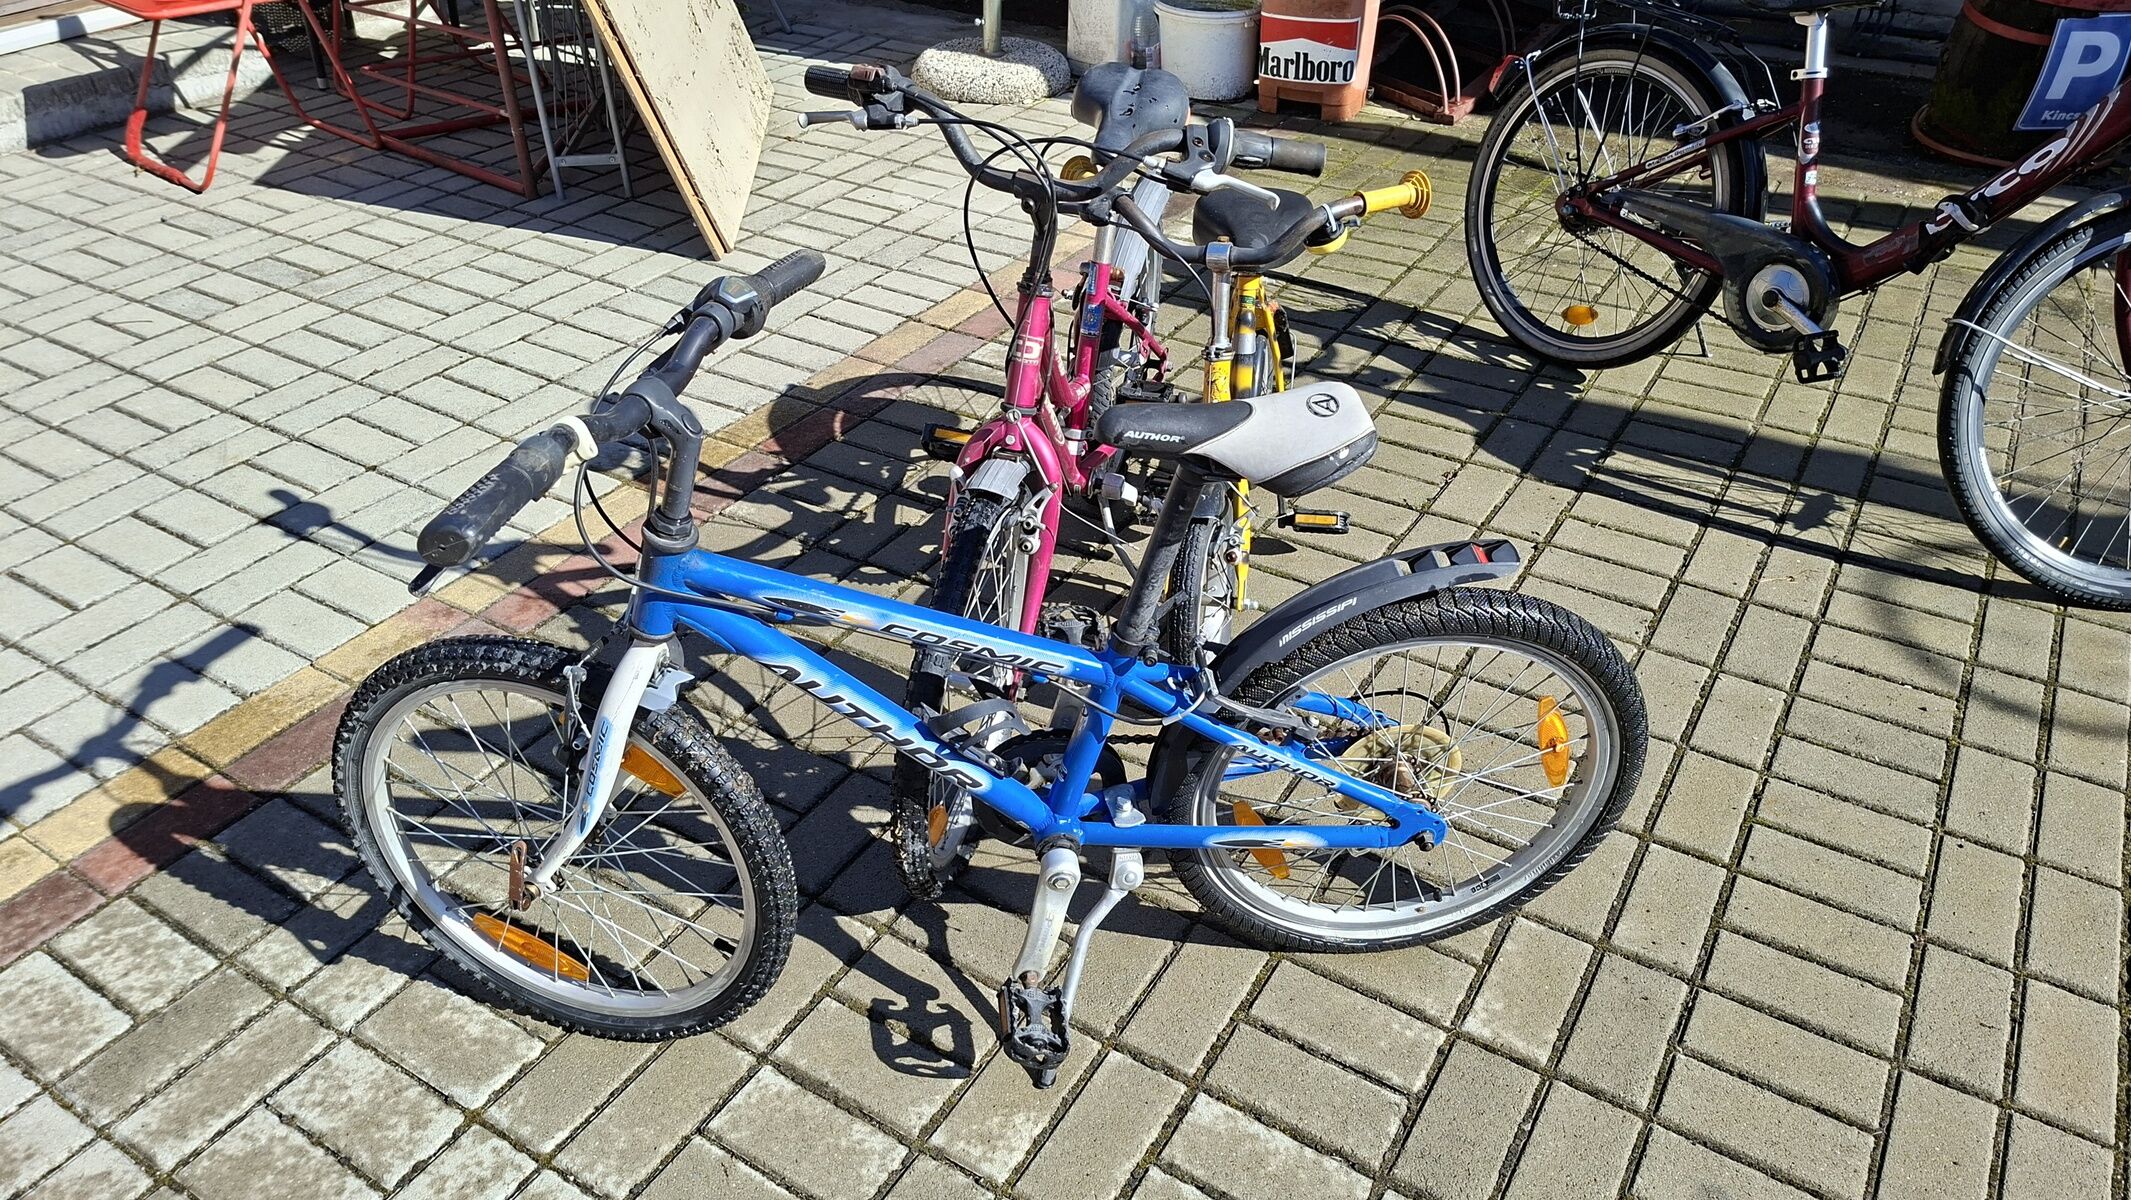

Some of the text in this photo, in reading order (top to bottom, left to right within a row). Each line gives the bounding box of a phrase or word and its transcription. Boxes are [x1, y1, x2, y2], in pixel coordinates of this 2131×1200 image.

[1259, 45, 1355, 82] Marlboro
[2044, 31, 2121, 100] P
[879, 623, 1066, 674] COSMIC
[758, 661, 984, 790] AUTHOR
[586, 720, 609, 798] COSMIC
[1232, 744, 1337, 789] AUTHOR
